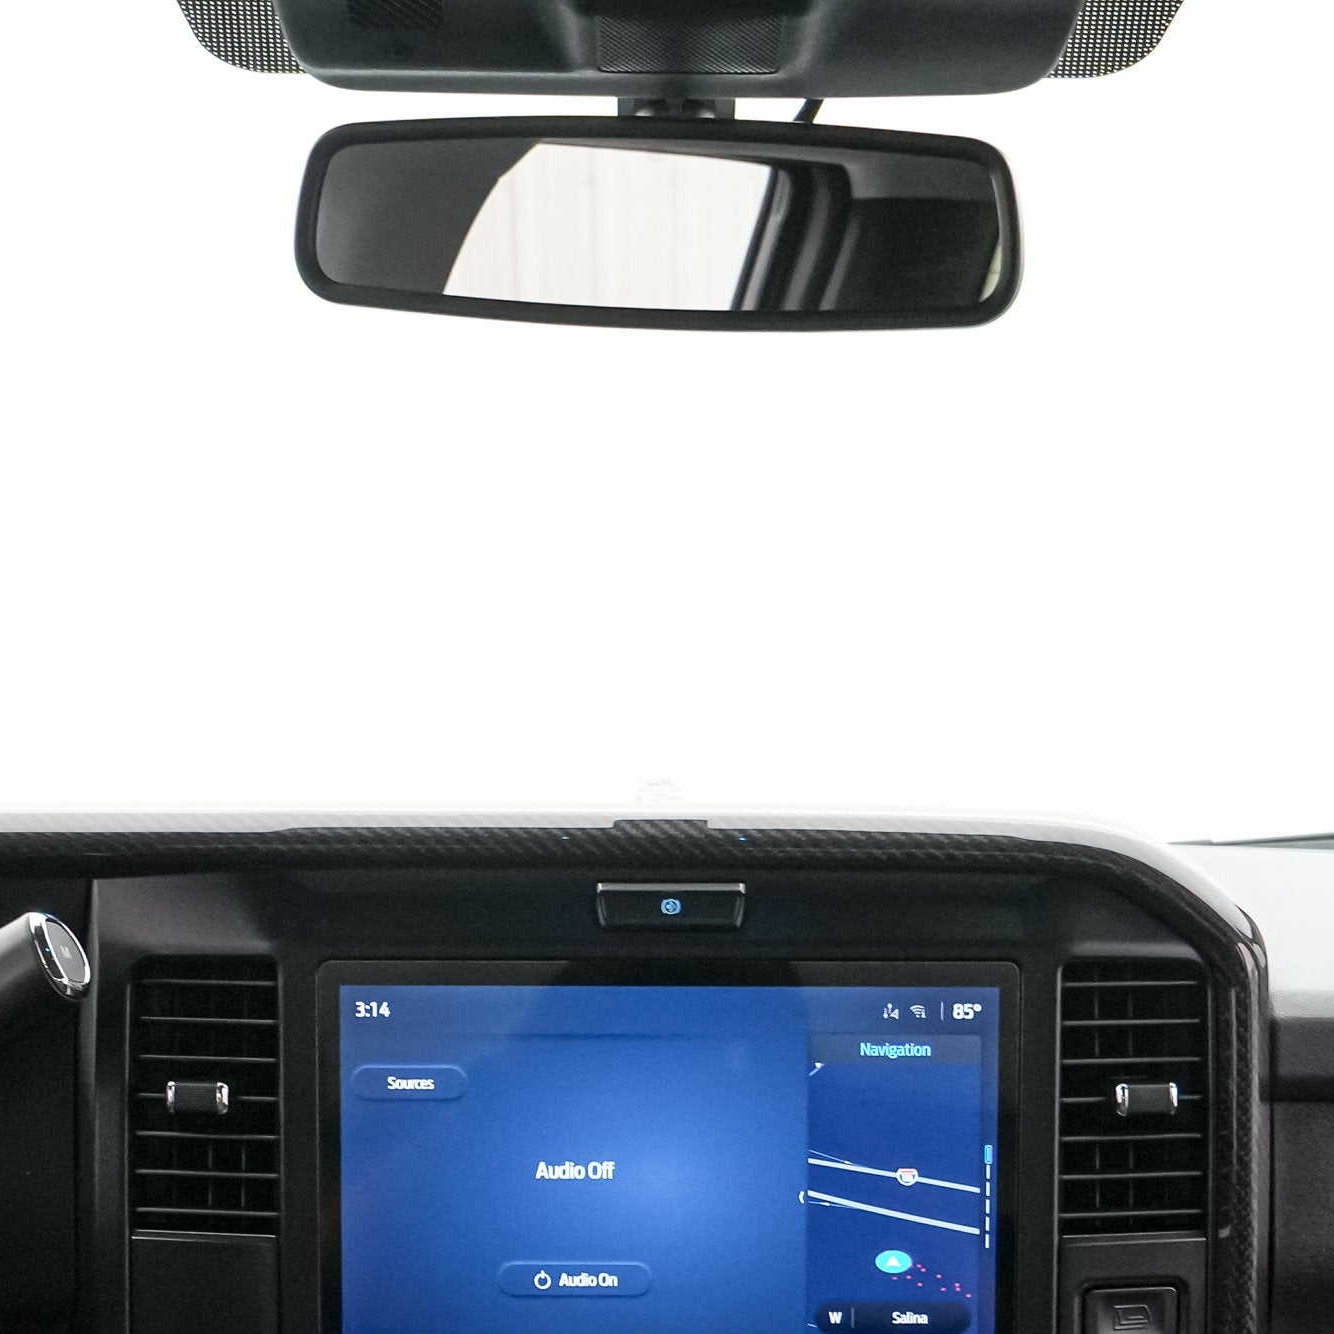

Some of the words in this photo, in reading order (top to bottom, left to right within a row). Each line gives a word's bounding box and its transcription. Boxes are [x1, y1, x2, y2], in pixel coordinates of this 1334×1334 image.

[354, 1001, 391, 1018] 3:14
[859, 1042, 932, 1059] Navigation
[386, 1076, 436, 1091] Sources
[534, 1161, 585, 1179] Audio
[587, 1161, 616, 1179] Off
[559, 1272, 597, 1287] Audio
[598, 1272, 618, 1287] On
[828, 1311, 843, 1324] W
[891, 1311, 929, 1324] Salina
